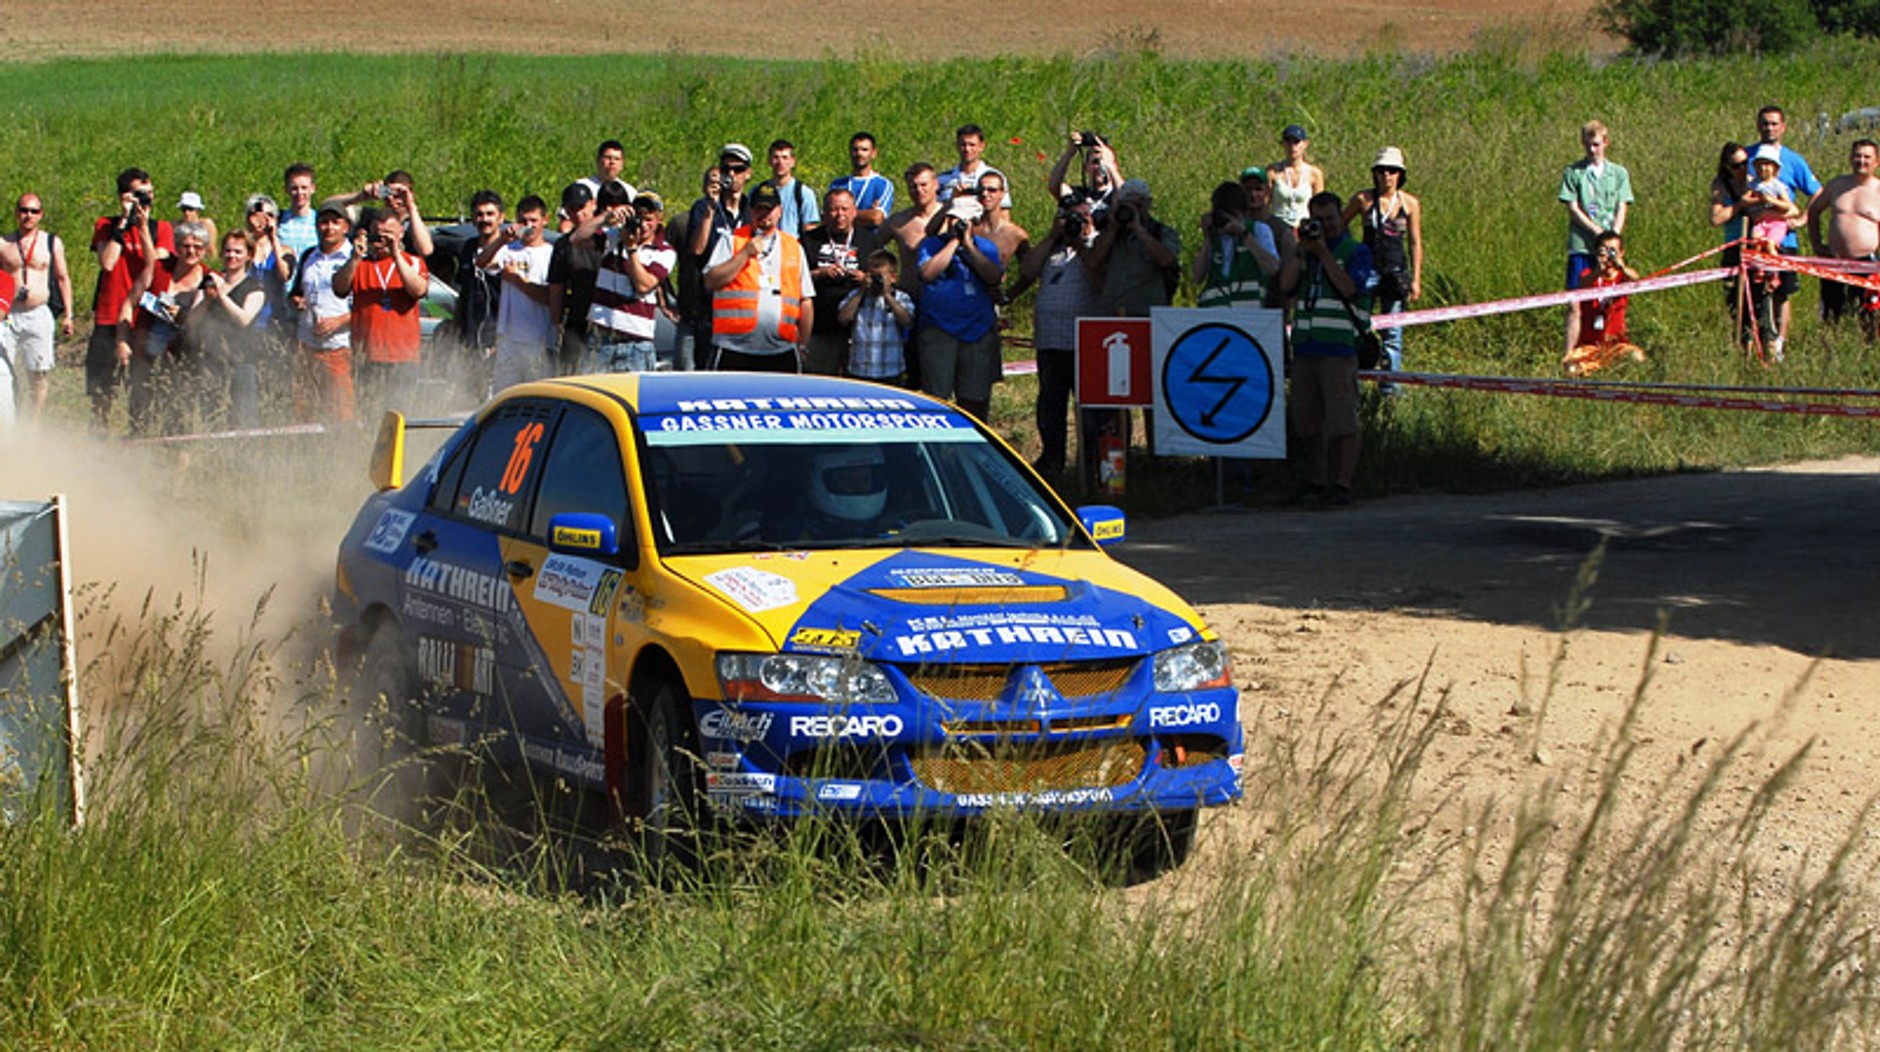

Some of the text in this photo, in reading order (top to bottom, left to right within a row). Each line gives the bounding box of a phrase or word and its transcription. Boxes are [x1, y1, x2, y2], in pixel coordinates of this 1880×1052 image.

[677, 396, 916, 412] KATHREIN
[660, 414, 953, 432] GASSNER MOTORSPORT
[499, 421, 544, 495] 16
[405, 556, 511, 613] KATHREIN
[895, 624, 1138, 656] KATHREIN
[790, 715, 904, 737] RECARO
[1150, 703, 1221, 727] RECARO
